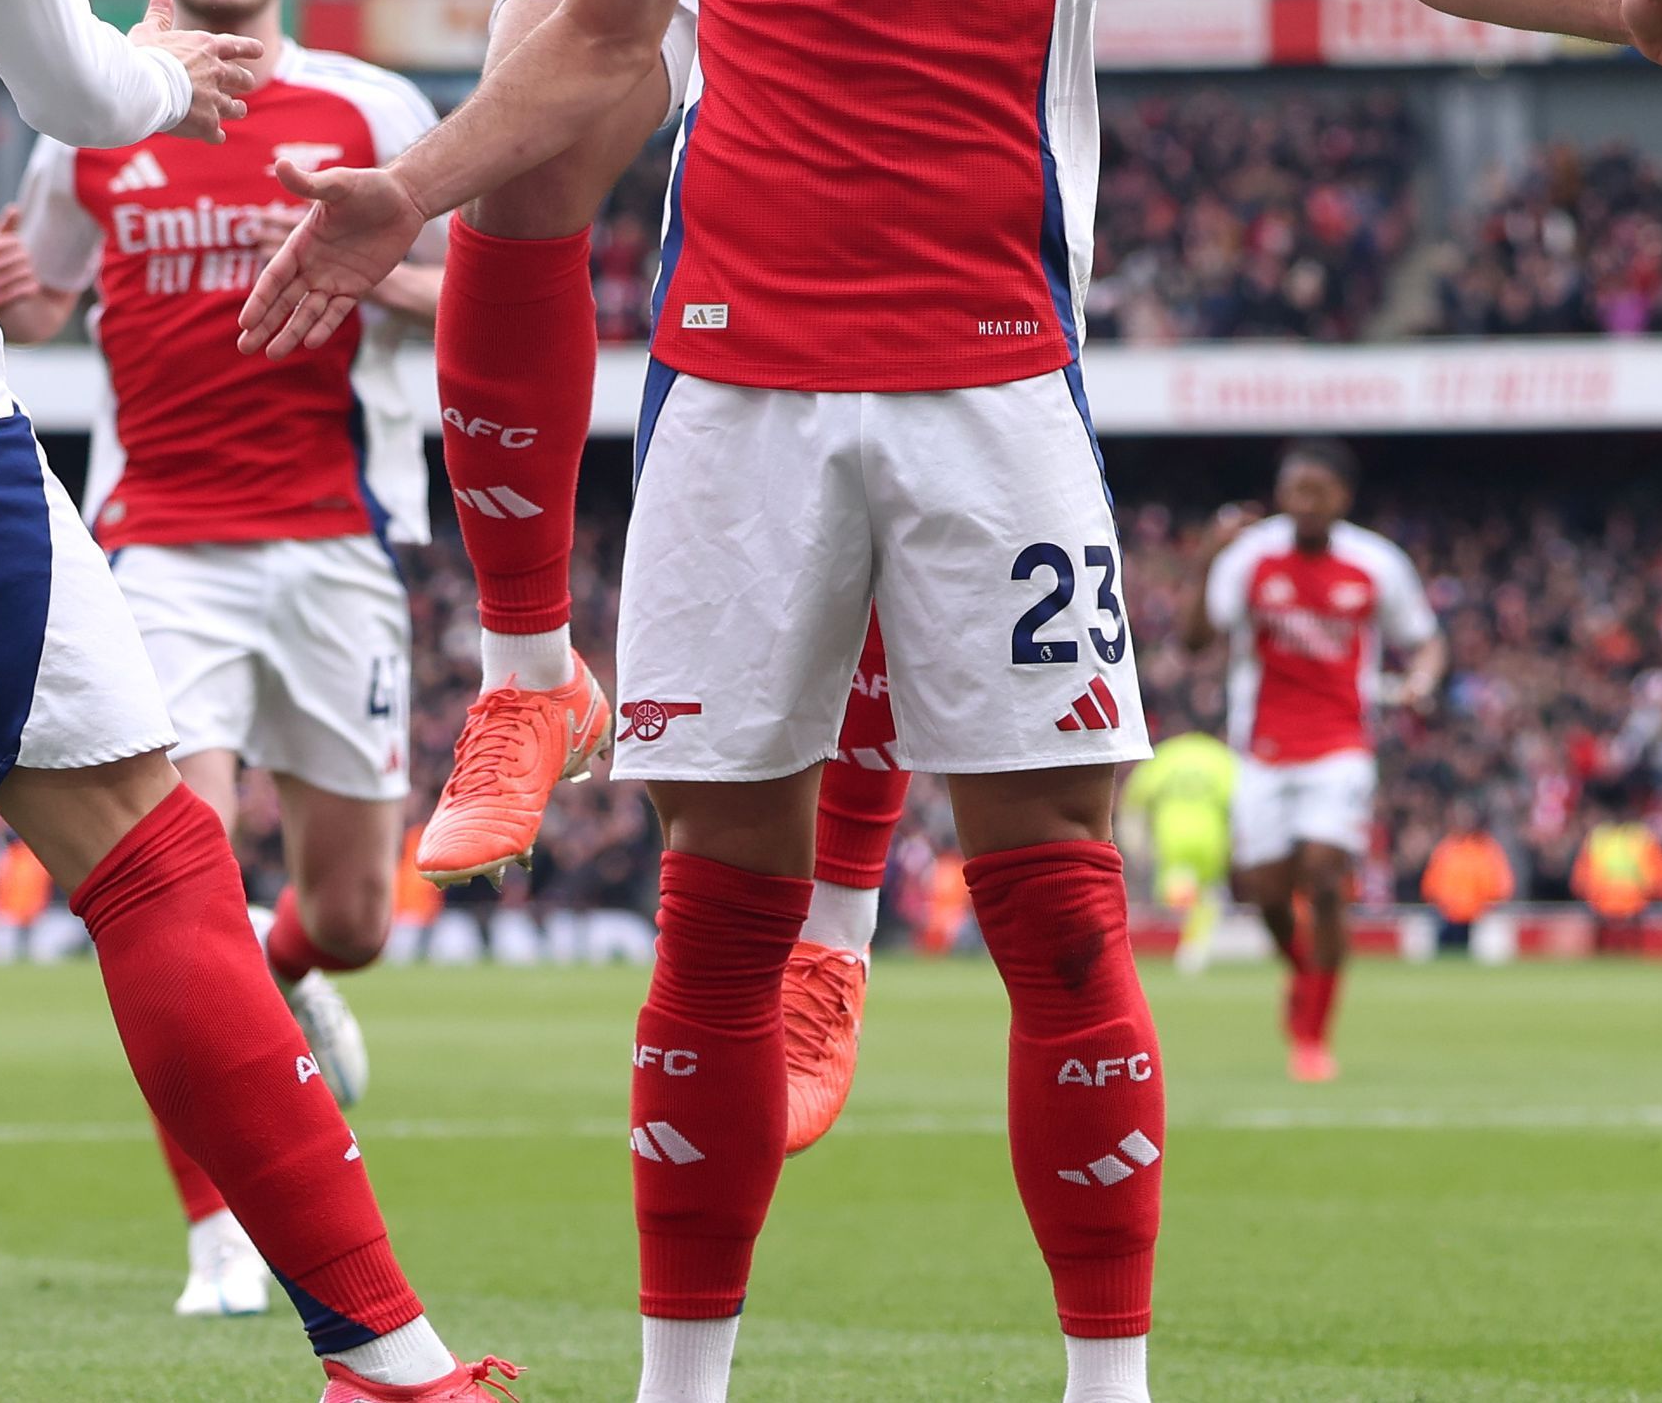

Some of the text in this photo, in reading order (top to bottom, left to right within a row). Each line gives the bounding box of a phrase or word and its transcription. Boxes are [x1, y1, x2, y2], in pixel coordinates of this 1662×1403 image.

[114, 196, 302, 254] Emira
[978, 321, 1039, 335] HEAT.RDY
[443, 407, 538, 449] AFC
[1010, 542, 1126, 665] 23
[852, 668, 889, 699] AF
[632, 1043, 698, 1076] FC
[1058, 1052, 1153, 1087] AFC
